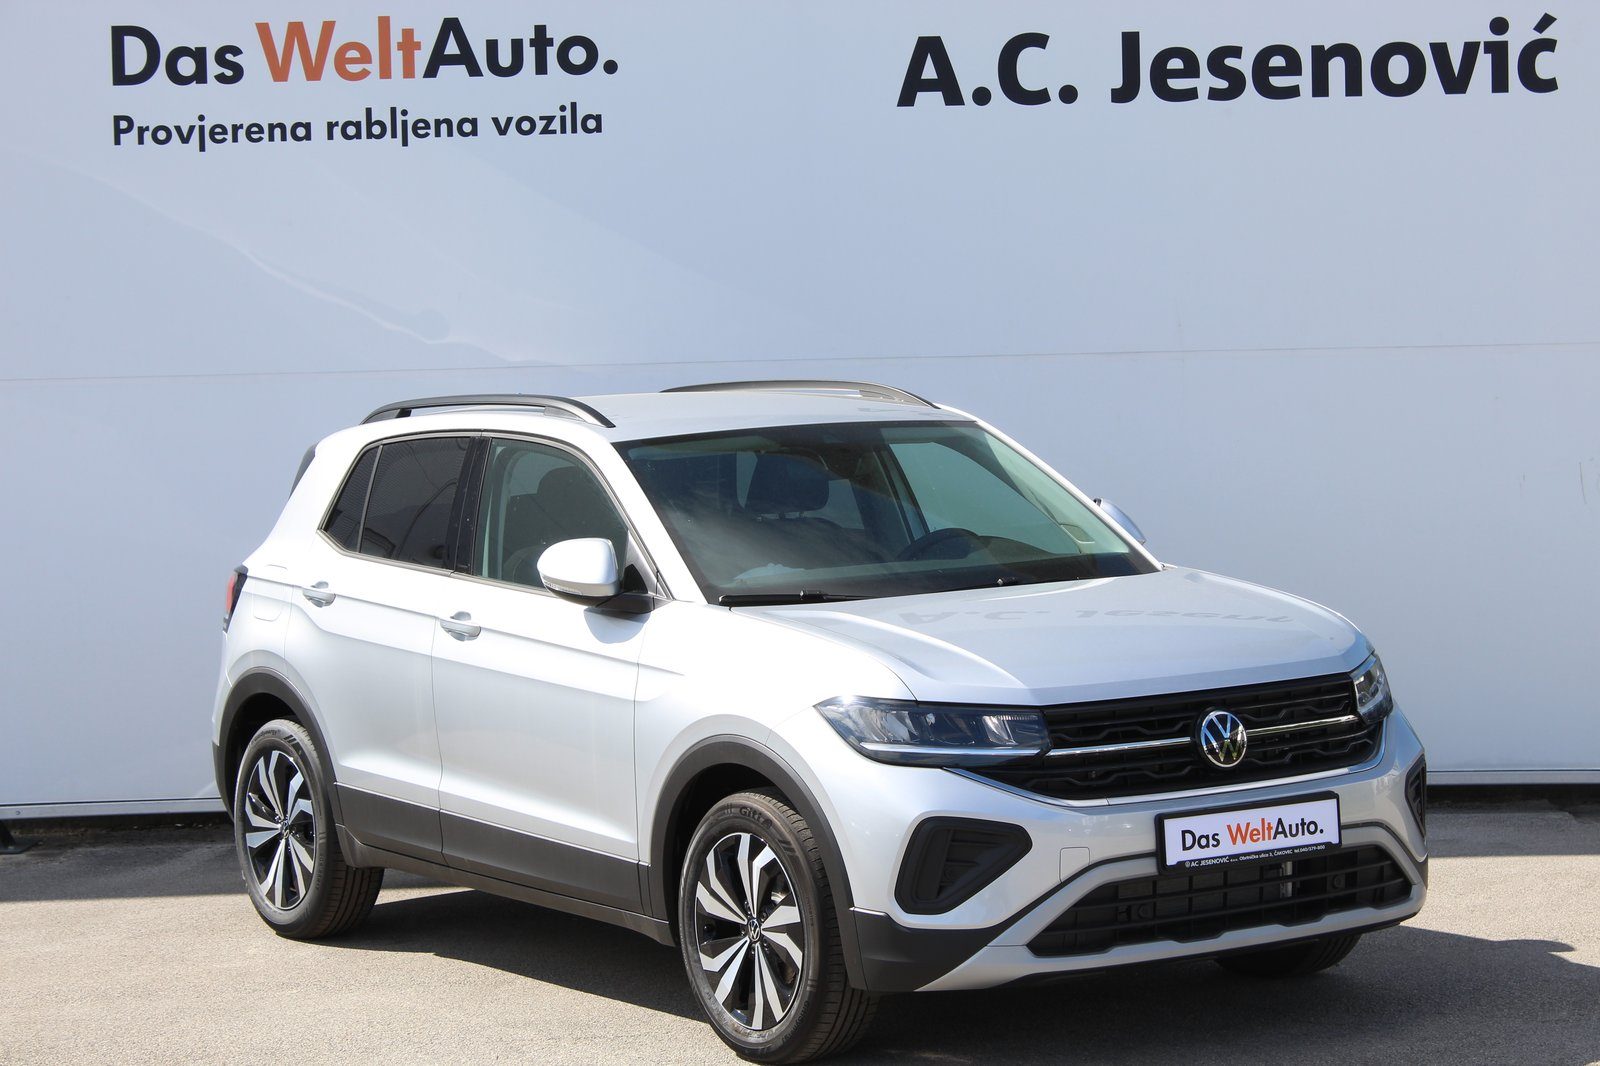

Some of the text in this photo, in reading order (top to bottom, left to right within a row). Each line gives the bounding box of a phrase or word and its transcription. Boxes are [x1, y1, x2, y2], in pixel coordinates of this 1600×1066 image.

[110, 15, 619, 86] Das WeltAuto.
[896, 12, 1559, 108] A.C. Jesenović
[113, 101, 603, 153] Provjerena rabljena vozila
[1181, 817, 1324, 852] Das WeltAuto.
[1190, 860, 1199, 868] AC
[1200, 856, 1230, 867] JESENOVIĆ
